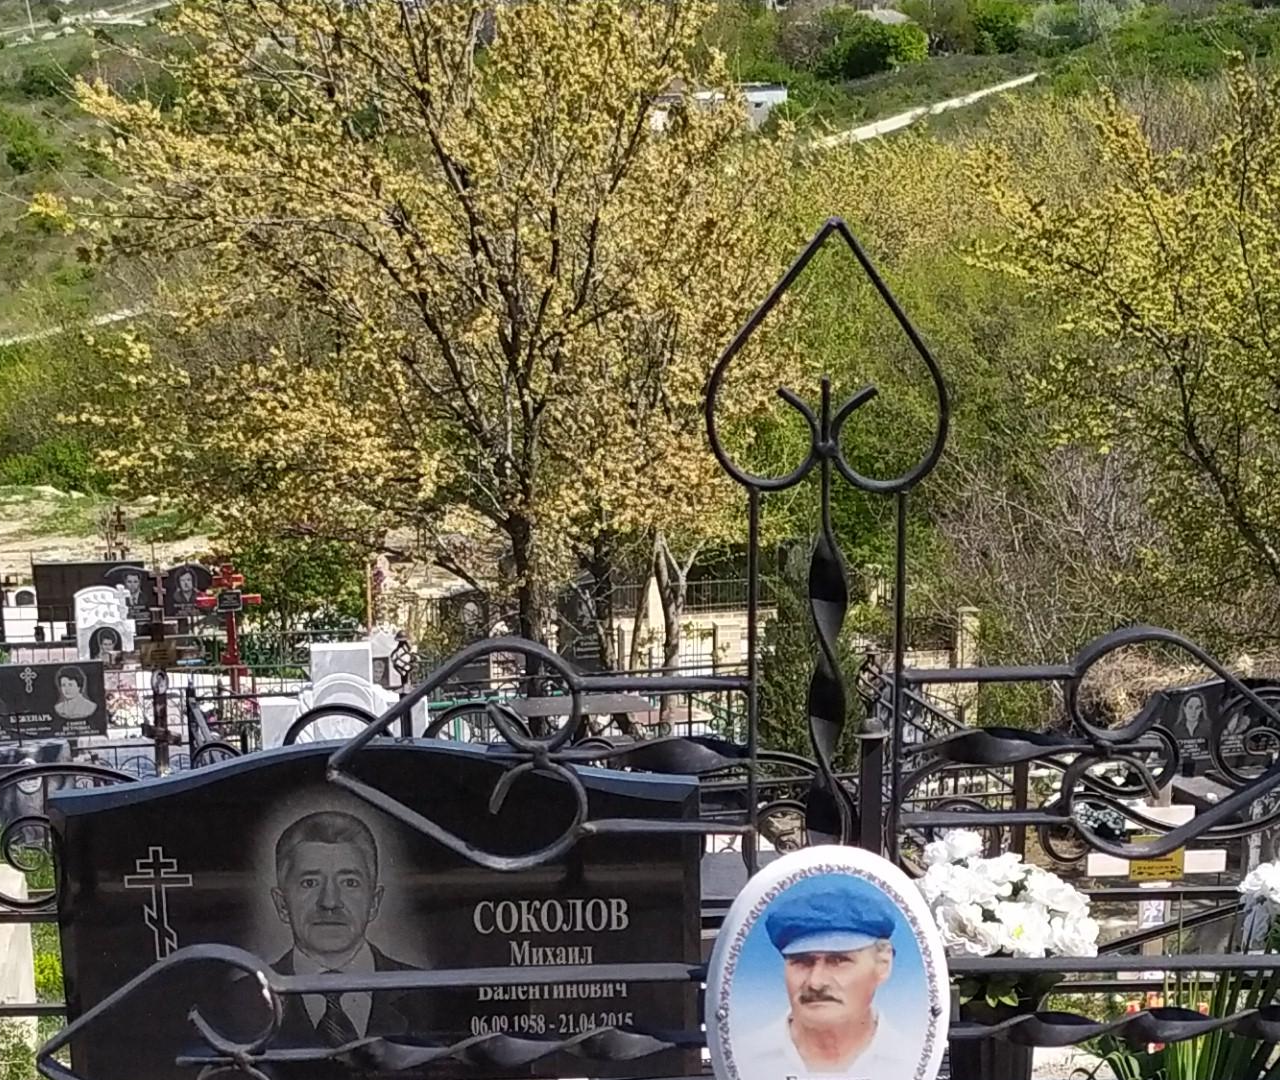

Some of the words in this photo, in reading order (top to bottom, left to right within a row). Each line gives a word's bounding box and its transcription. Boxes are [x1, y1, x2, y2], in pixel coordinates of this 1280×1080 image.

[473, 898, 629, 934] СОКОЛОВ
[509, 940, 593, 966] Михаил
[471, 1014, 546, 1036] 06.09.1958
[559, 1012, 633, 1035] 21.042015
